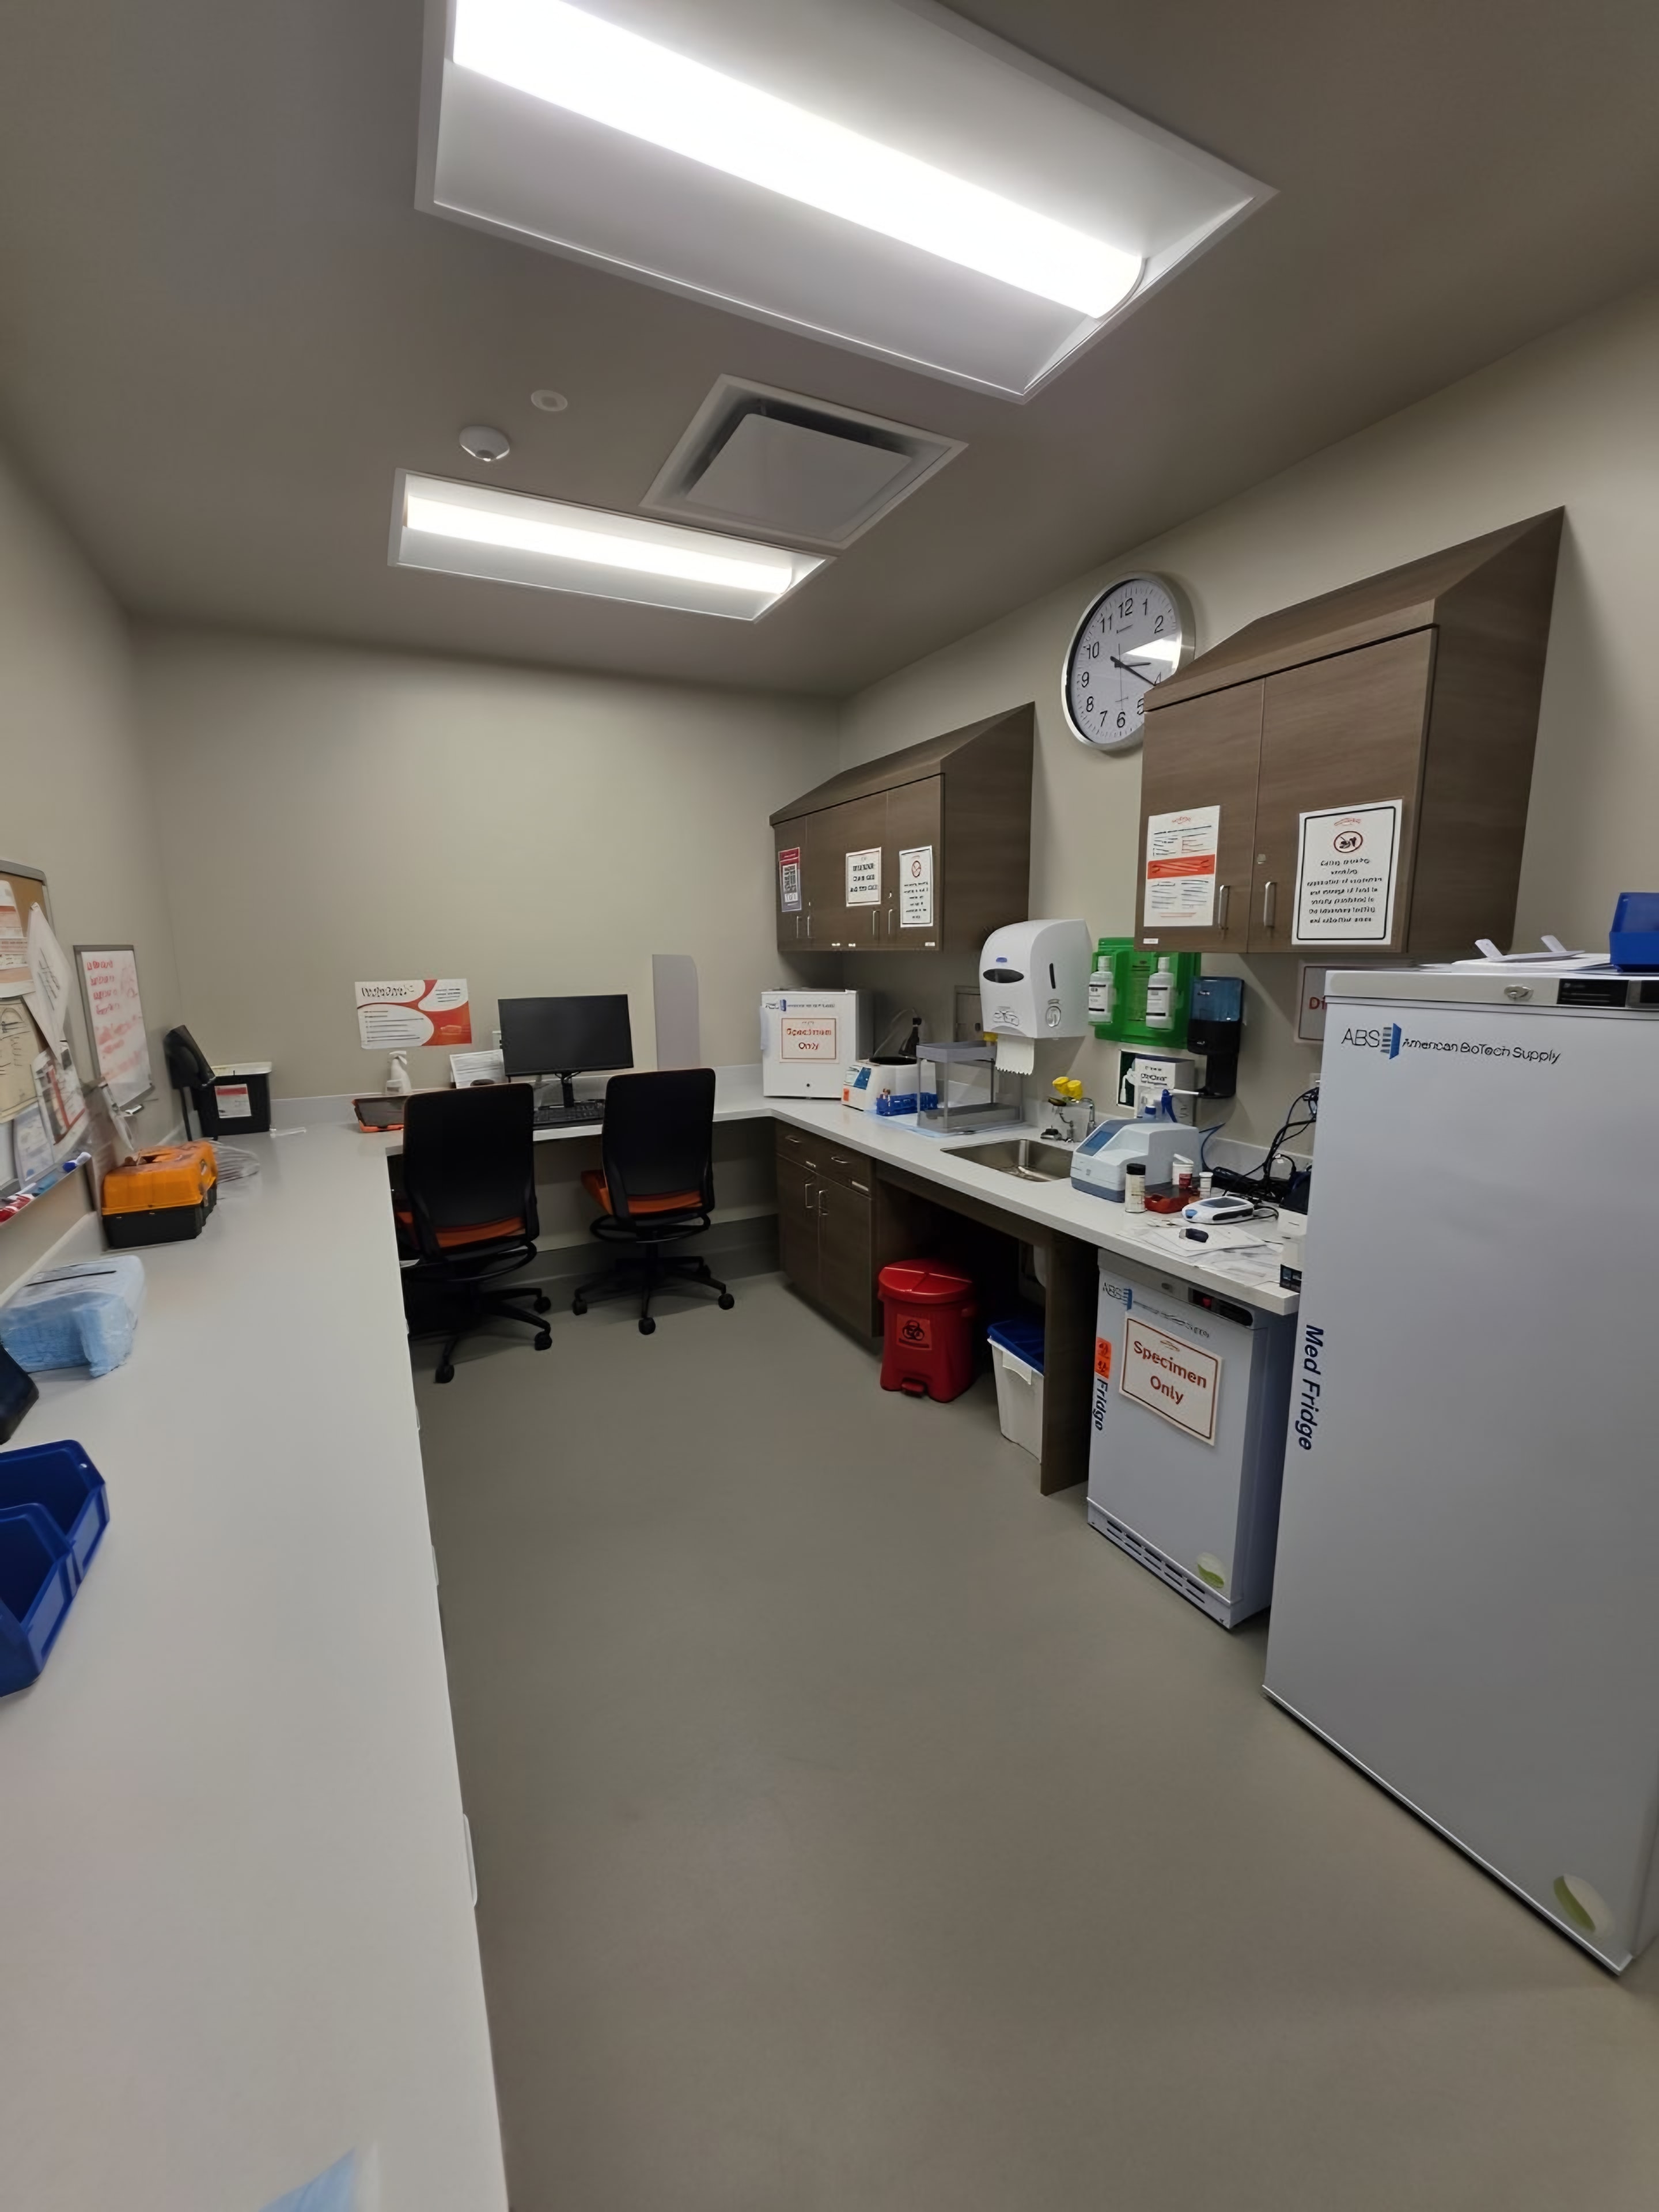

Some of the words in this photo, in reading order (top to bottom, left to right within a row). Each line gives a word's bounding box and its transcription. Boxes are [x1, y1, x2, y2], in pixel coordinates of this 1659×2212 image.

[1118, 598, 1134, 618] 12
[1142, 599, 1149, 616] 1
[1100, 613, 1114, 633] 11
[1154, 615, 1164, 634] 2
[1086, 641, 1100, 660] 10
[1081, 672, 1090, 688] 9
[1086, 696, 1094, 712] 8
[1100, 710, 1108, 727] 7
[1116, 712, 1126, 728] 6
[1341, 1028, 1380, 1047] ABS
[1512, 1047, 1561, 1065] Supply
[1304, 1324, 1324, 1375] Med
[1134, 1340, 1207, 1389] Specimen
[1150, 1376, 1184, 1405] Only
[1295, 1378, 1320, 1450] Fridge
